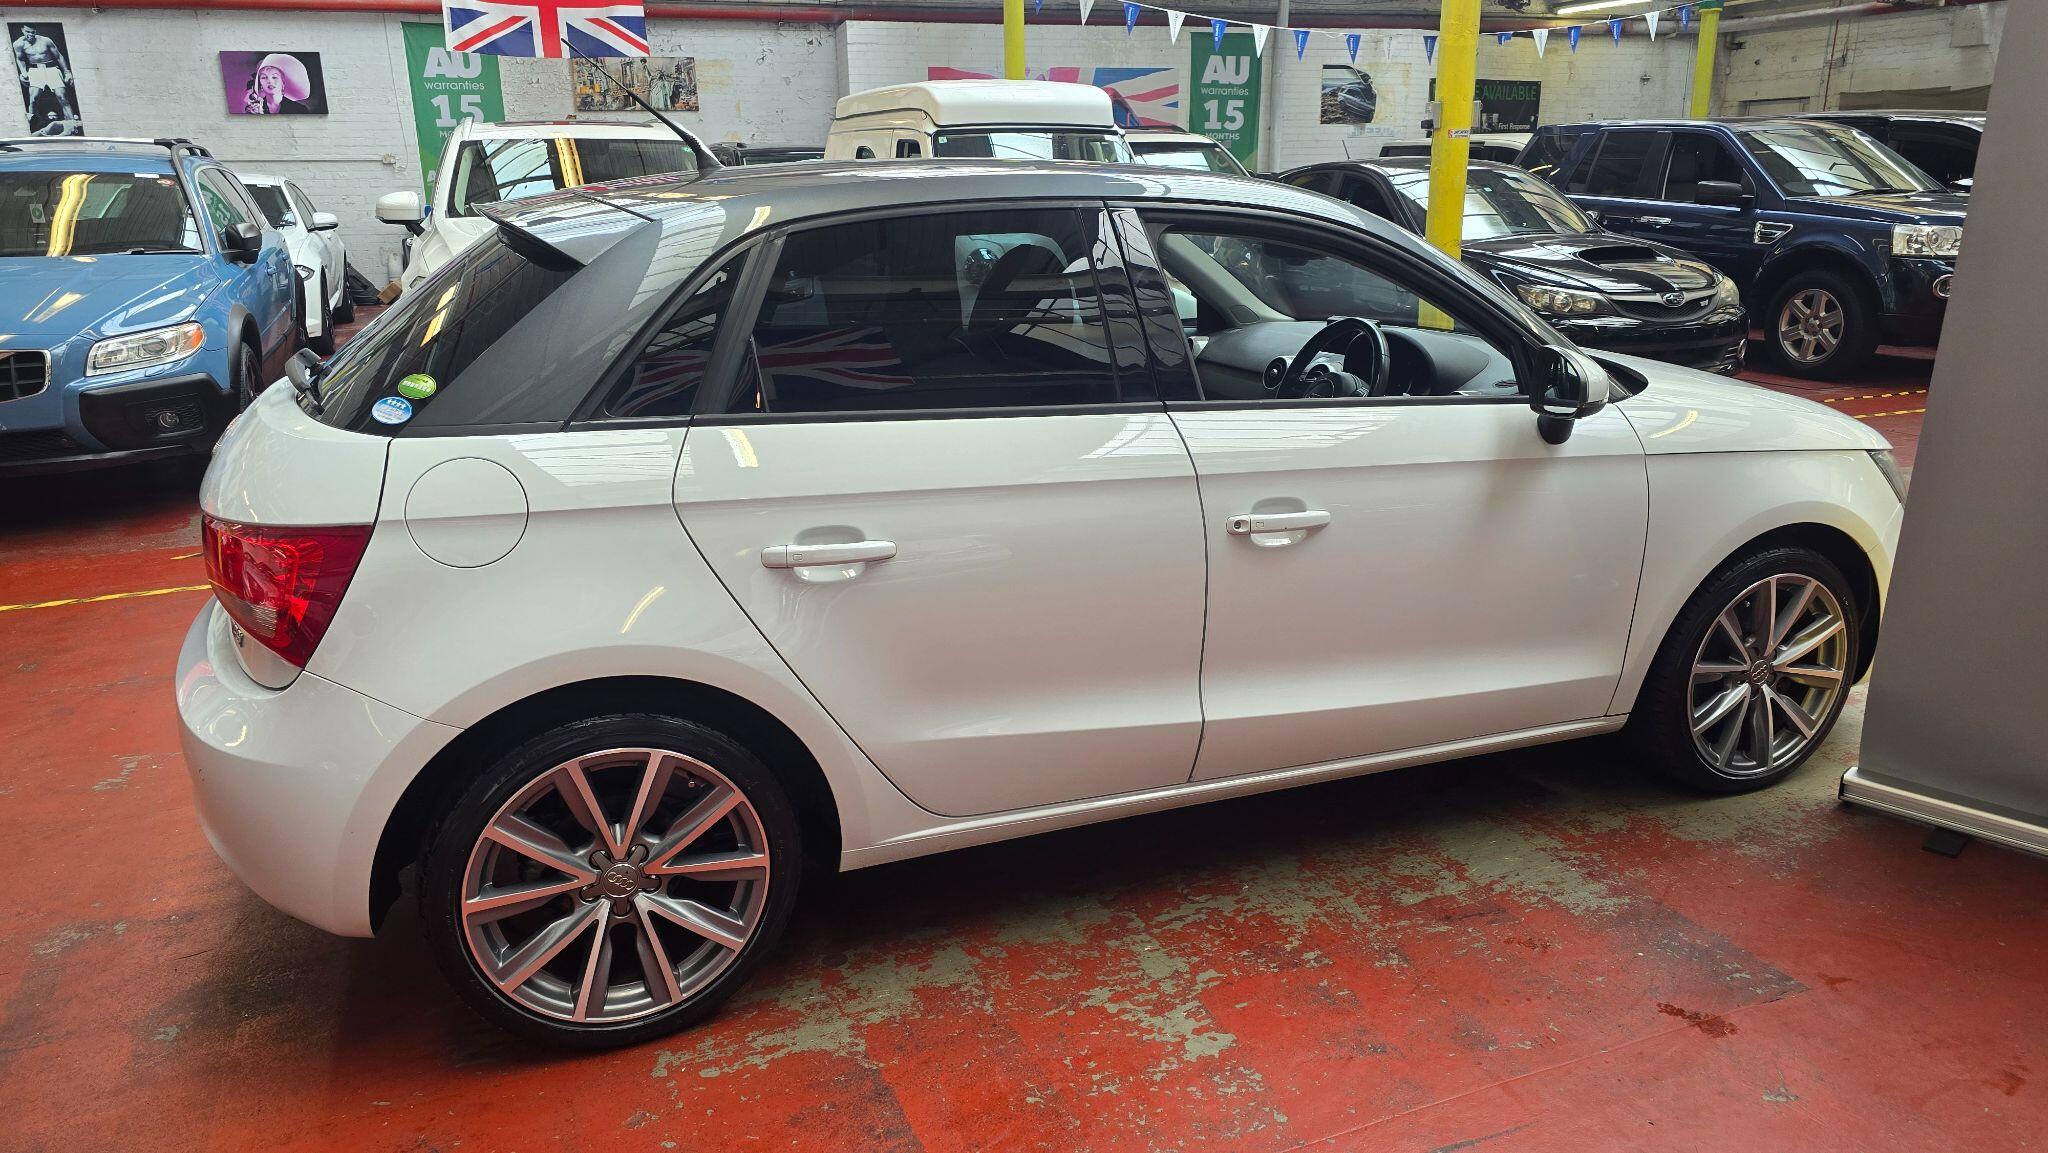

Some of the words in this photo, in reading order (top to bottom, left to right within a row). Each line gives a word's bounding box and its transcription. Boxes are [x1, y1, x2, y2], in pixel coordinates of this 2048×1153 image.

[423, 46, 482, 79] AU
[1201, 54, 1250, 85] AU
[424, 80, 485, 91] warranties
[1201, 86, 1249, 96] warranties
[1482, 84, 1537, 100] AVAILABLE
[430, 94, 485, 128] 15
[1203, 99, 1245, 131] 15
